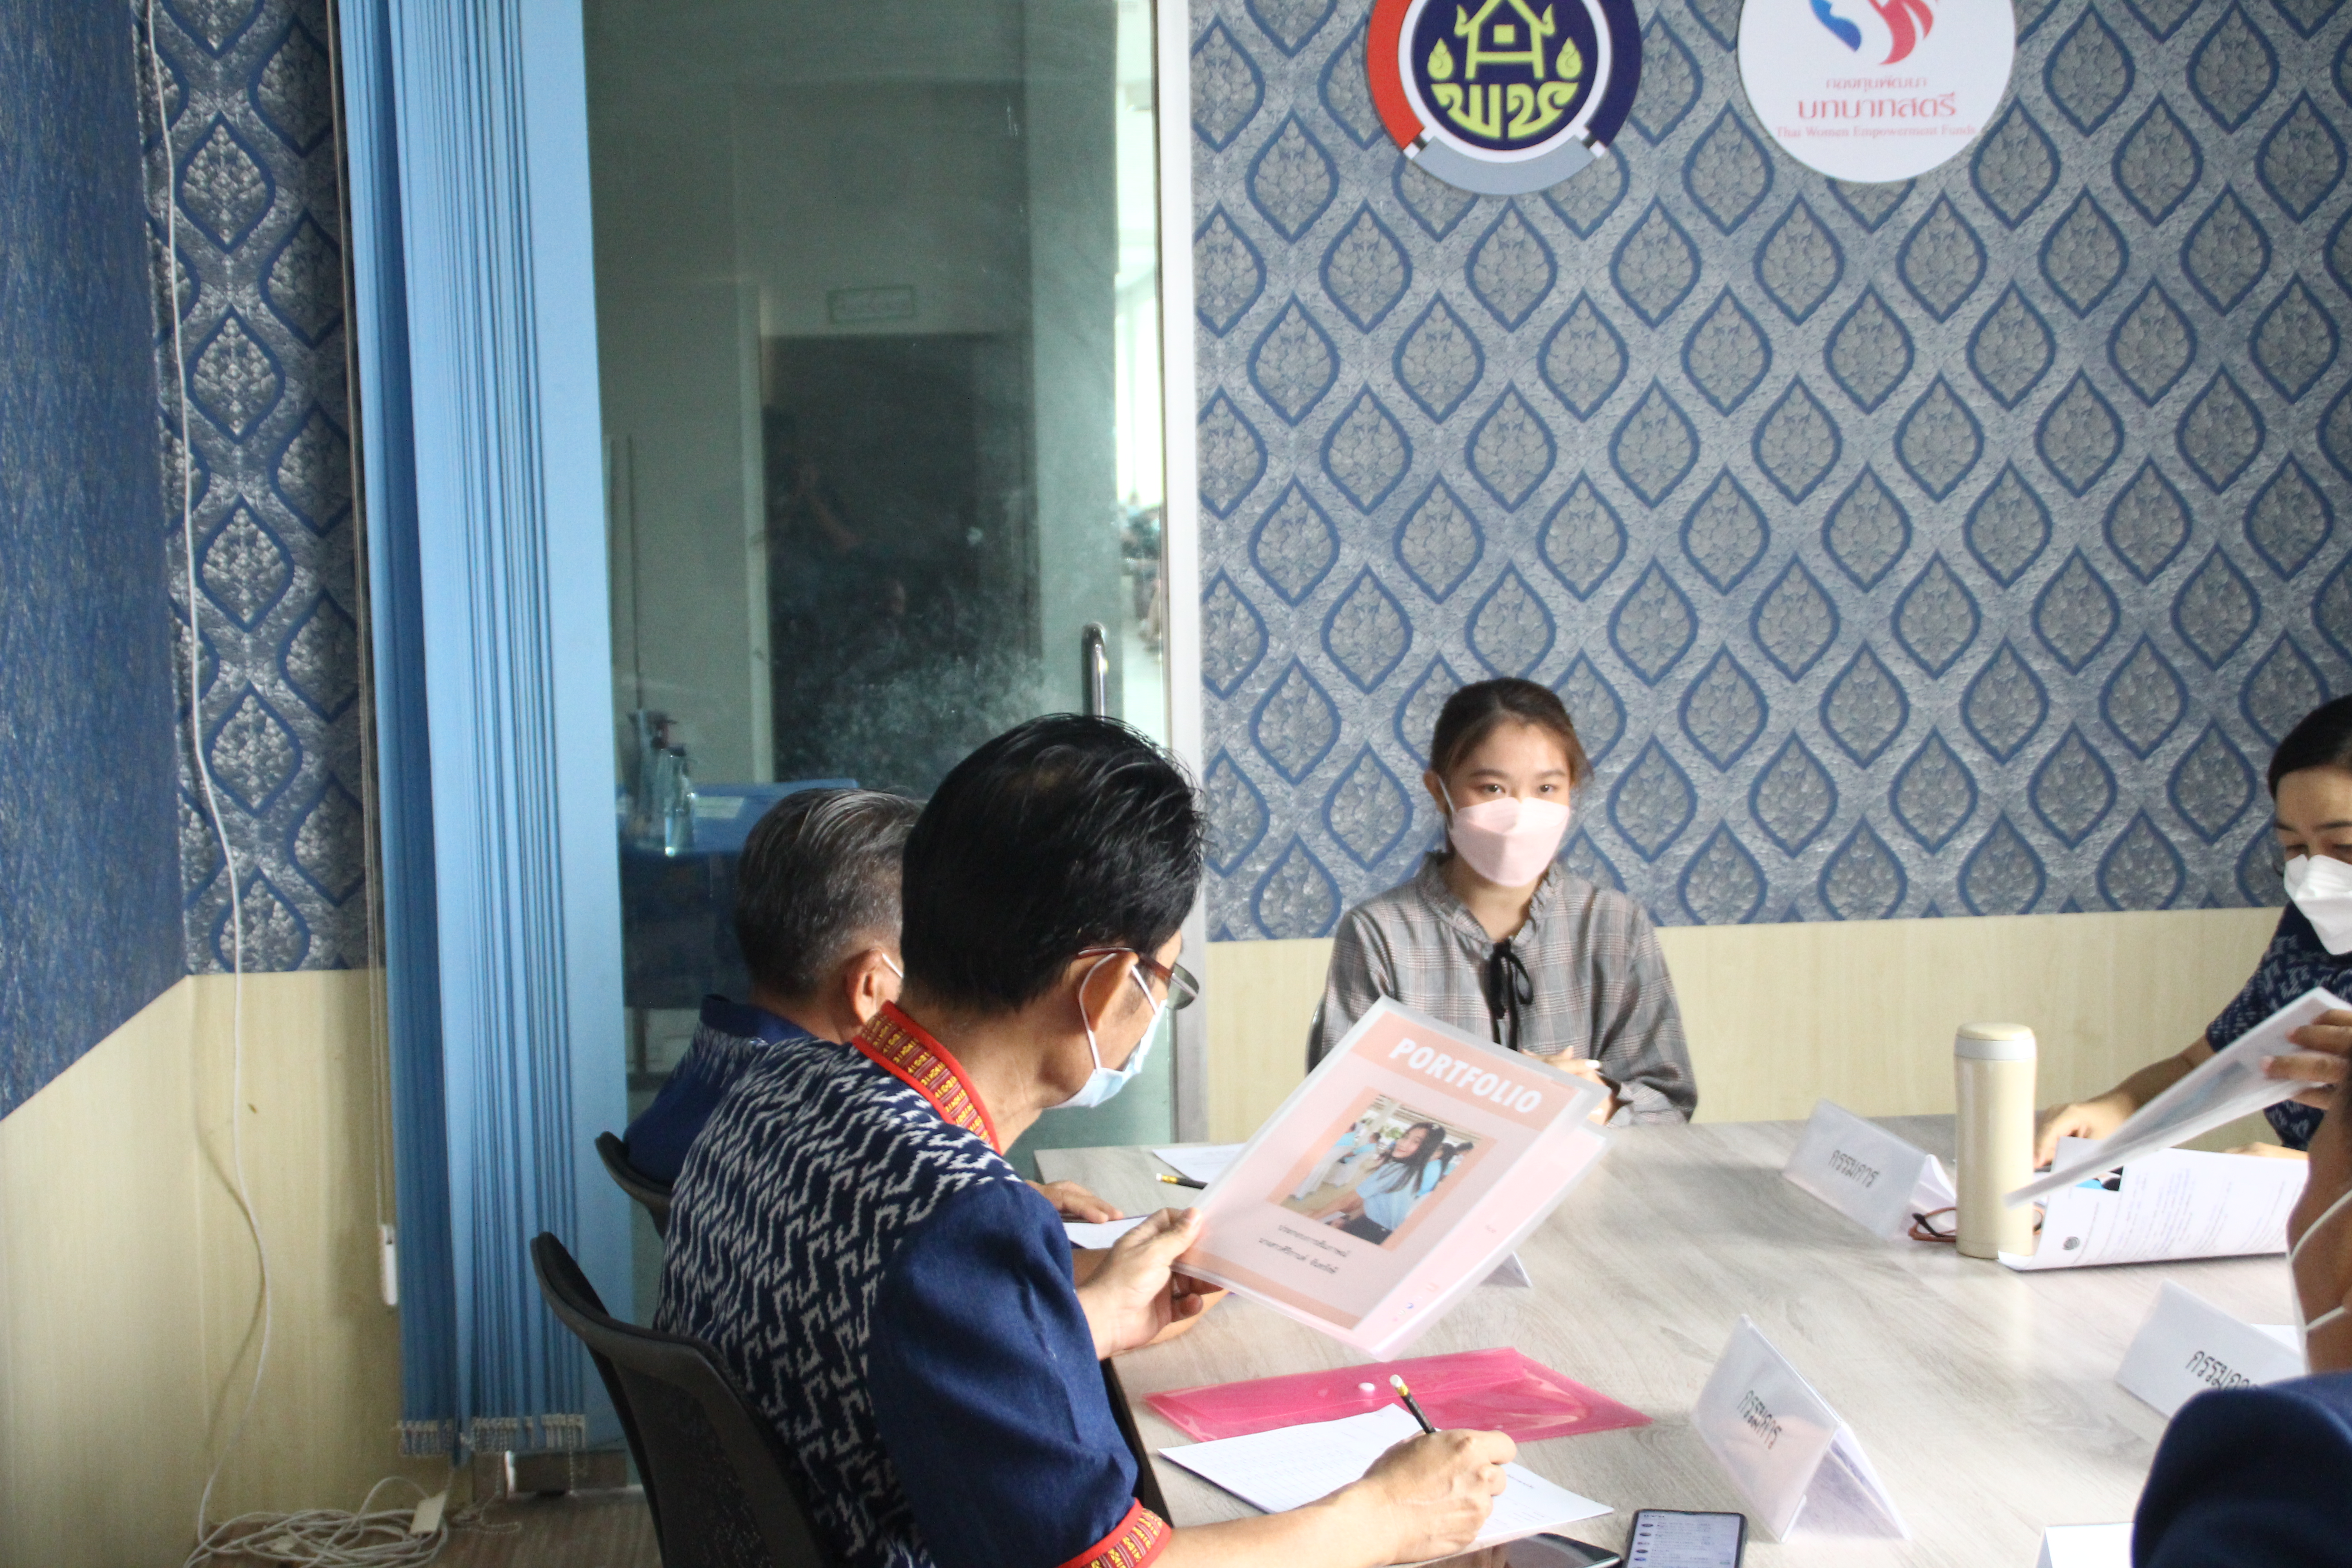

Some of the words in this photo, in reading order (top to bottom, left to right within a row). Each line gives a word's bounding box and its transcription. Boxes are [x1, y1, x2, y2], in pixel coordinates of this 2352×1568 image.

[1806, 126, 1849, 137] Women
[1853, 126, 1937, 138] Empowerment
[1389, 1038, 1542, 1113] PORTFOLIO
[1828, 1149, 1879, 1187] กรรมการ
